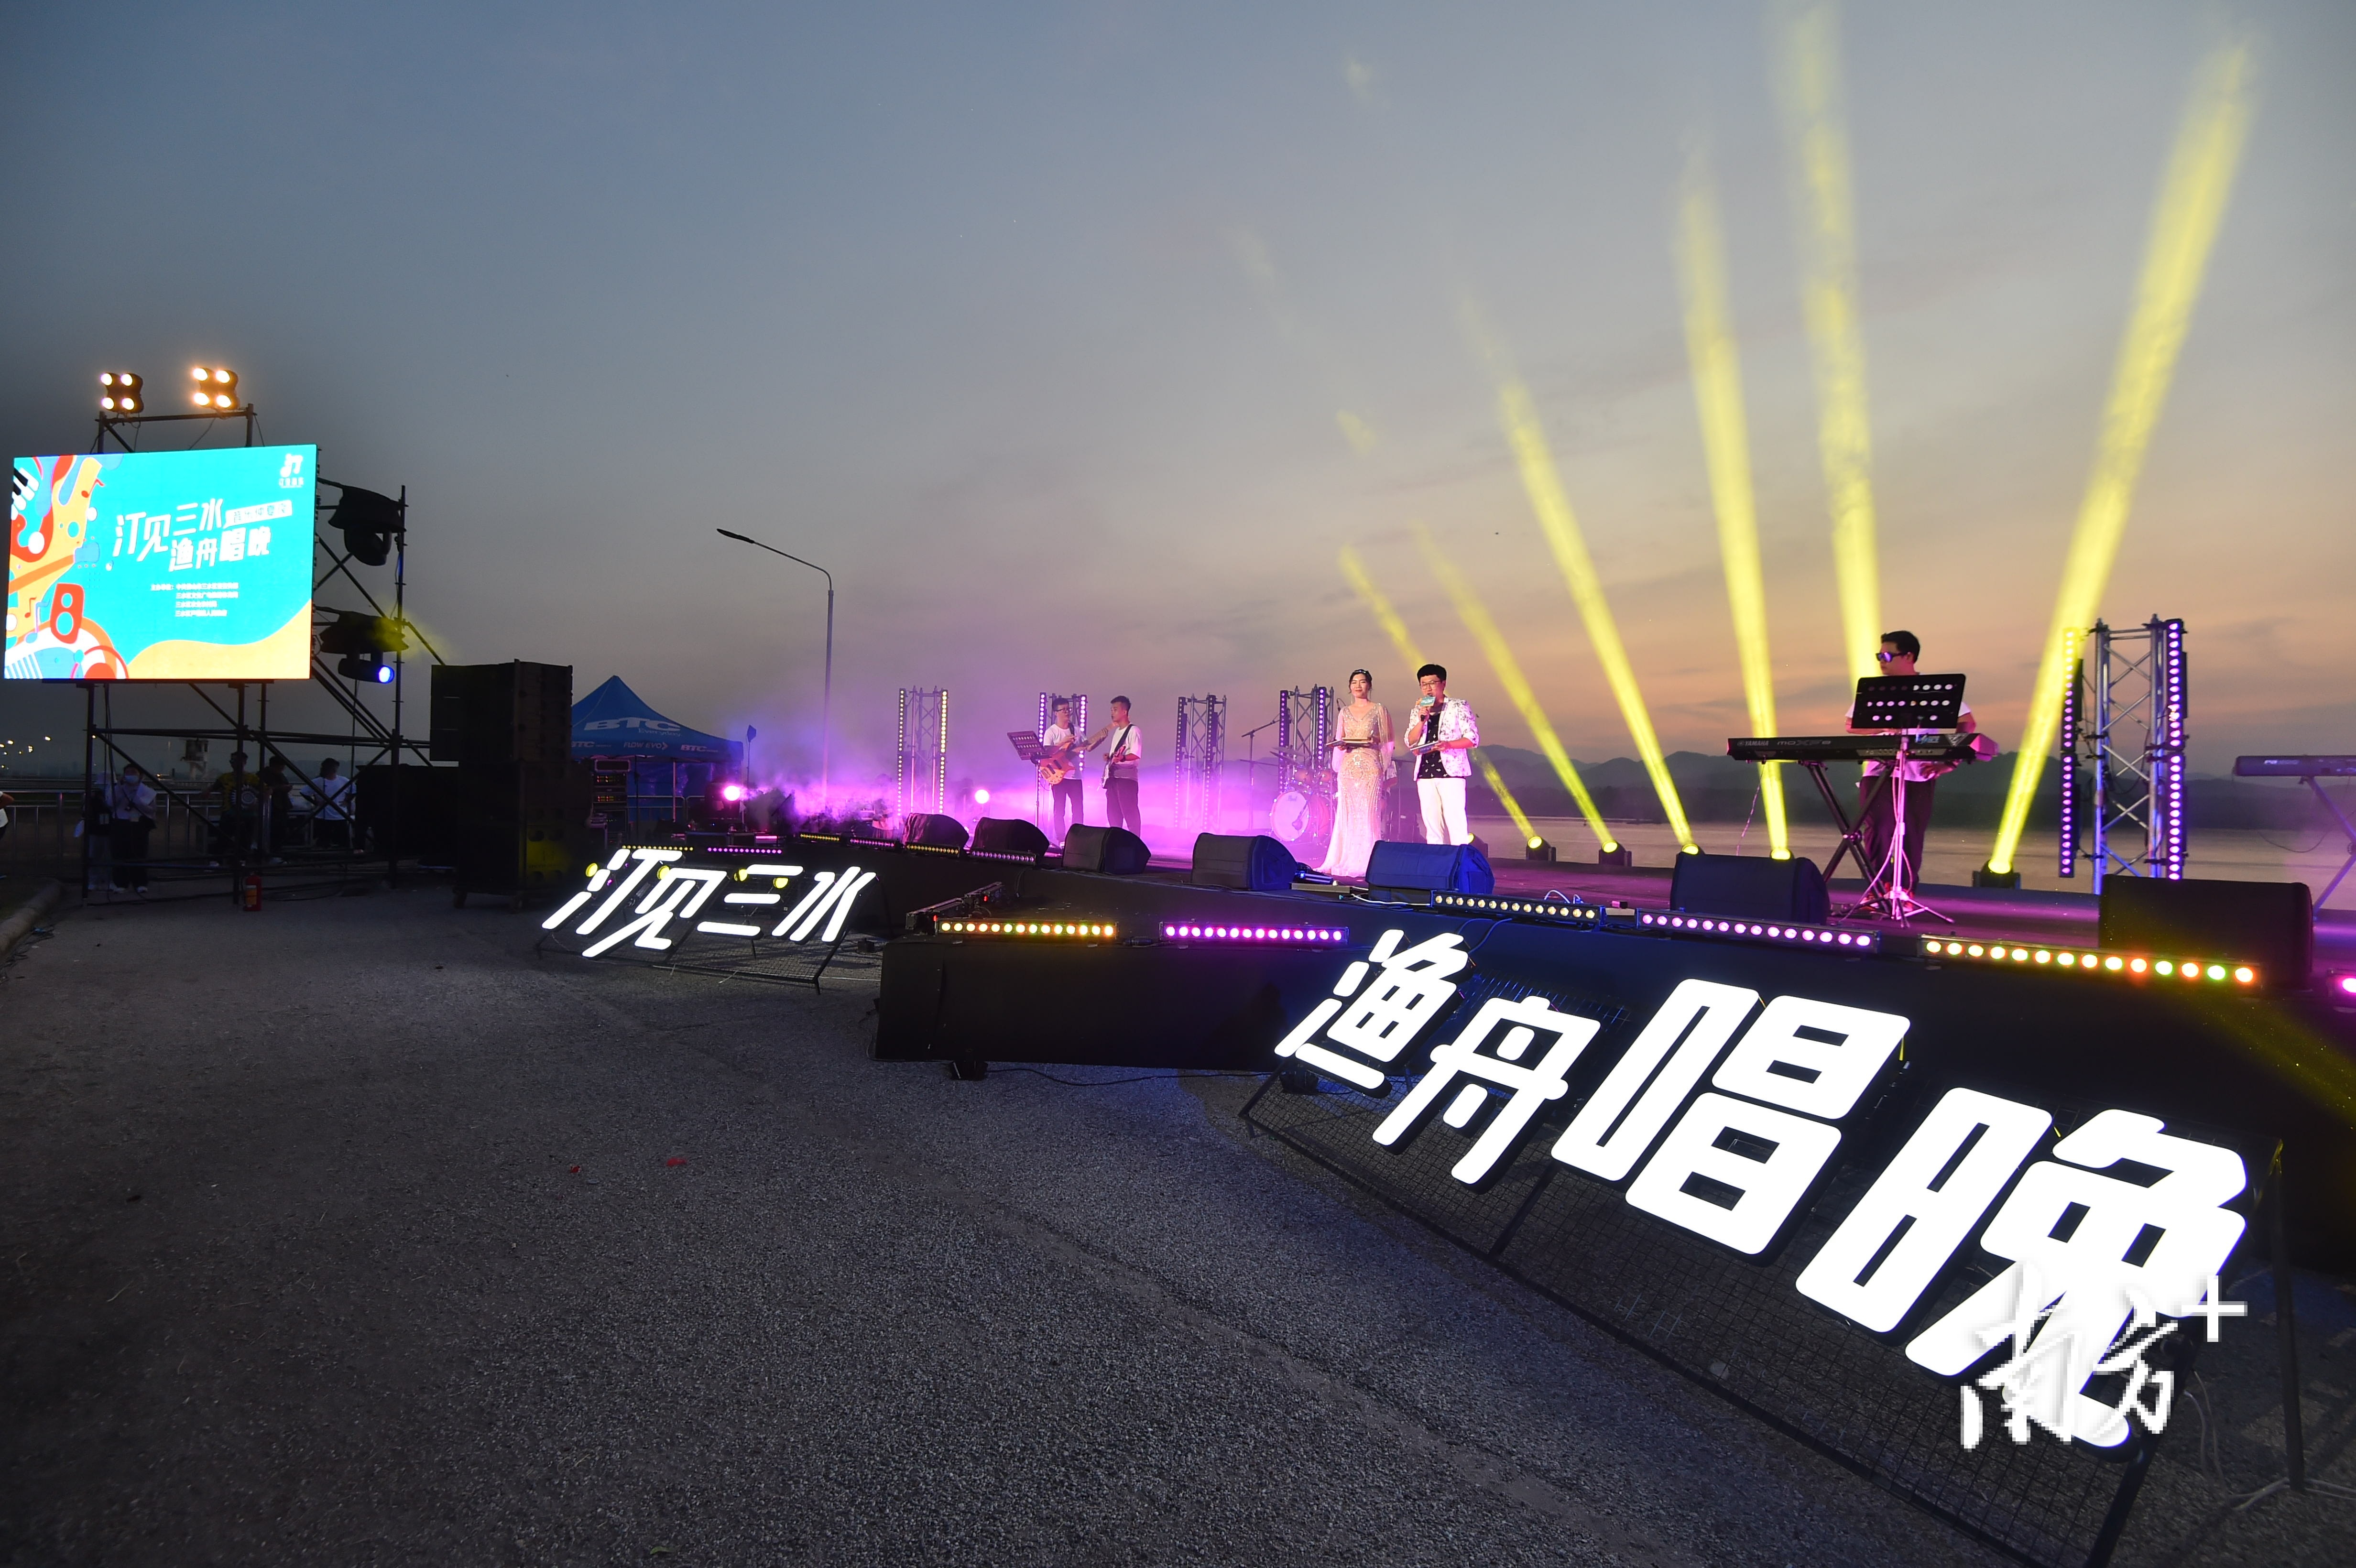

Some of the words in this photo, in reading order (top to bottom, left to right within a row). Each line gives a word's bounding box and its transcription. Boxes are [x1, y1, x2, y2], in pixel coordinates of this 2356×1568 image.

[113, 498, 224, 562] 汀见三水
[168, 526, 271, 572] 渔舟唱晚
[584, 717, 681, 731] BTC
[541, 848, 876, 958] 汀见三水
[1274, 929, 2247, 1448] 渔舟唱晚
